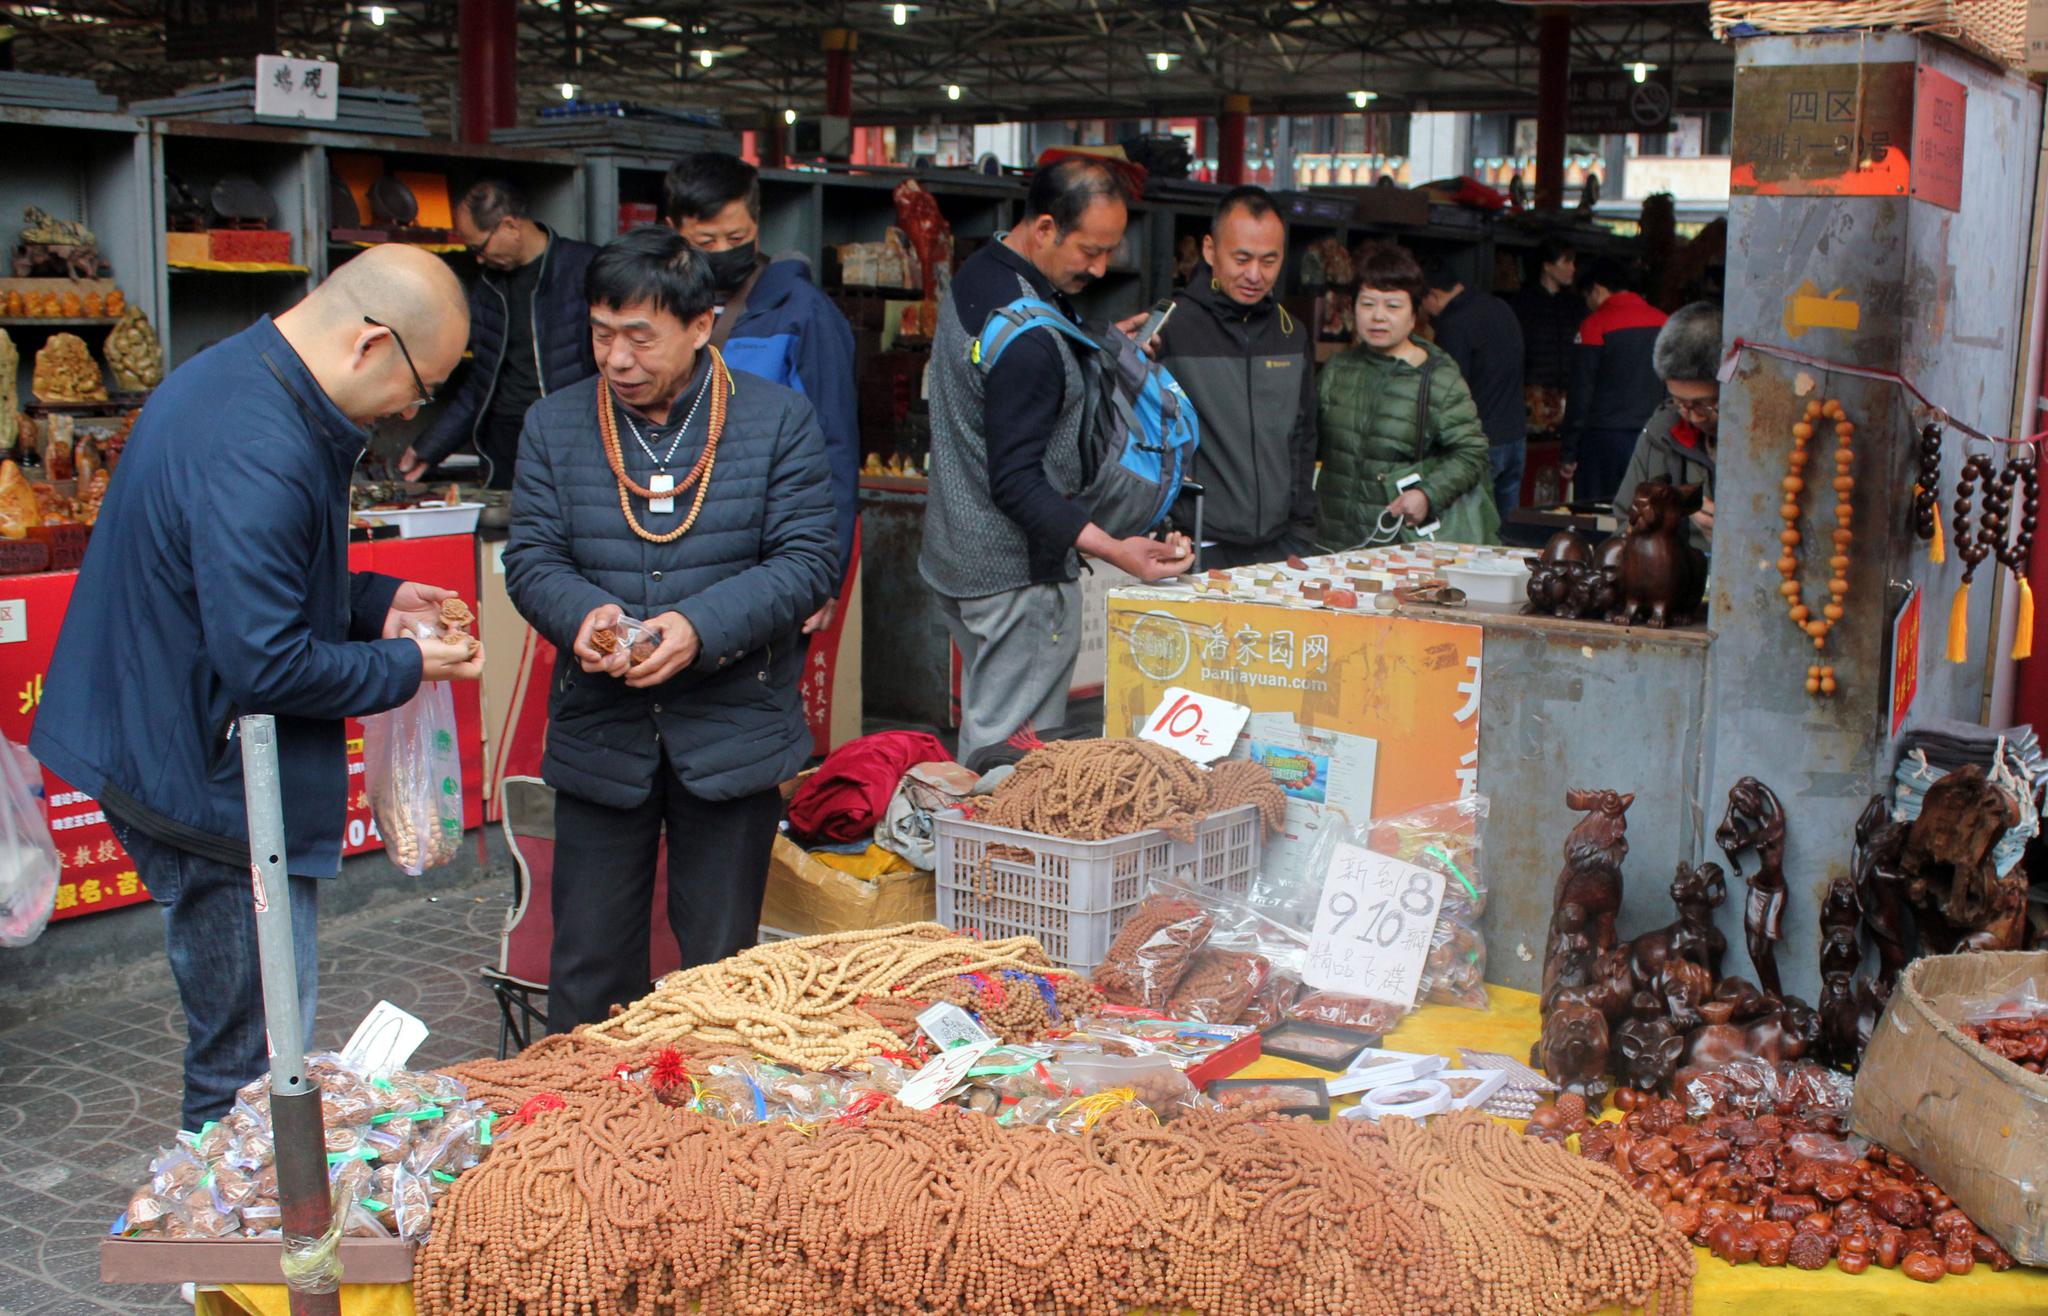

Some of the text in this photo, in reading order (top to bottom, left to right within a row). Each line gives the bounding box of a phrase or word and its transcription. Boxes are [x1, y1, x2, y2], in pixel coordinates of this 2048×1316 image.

[1789, 90, 1858, 122] 四区
[1201, 622, 1329, 674] 潘家园网
[1200, 666, 1328, 692] panjiayuan.com
[1152, 694, 1215, 747] 10 元
[1328, 891, 1359, 935] 9
[1356, 899, 1406, 948] 10
[1400, 872, 1436, 917] 8
[346, 1008, 404, 1074] 10
